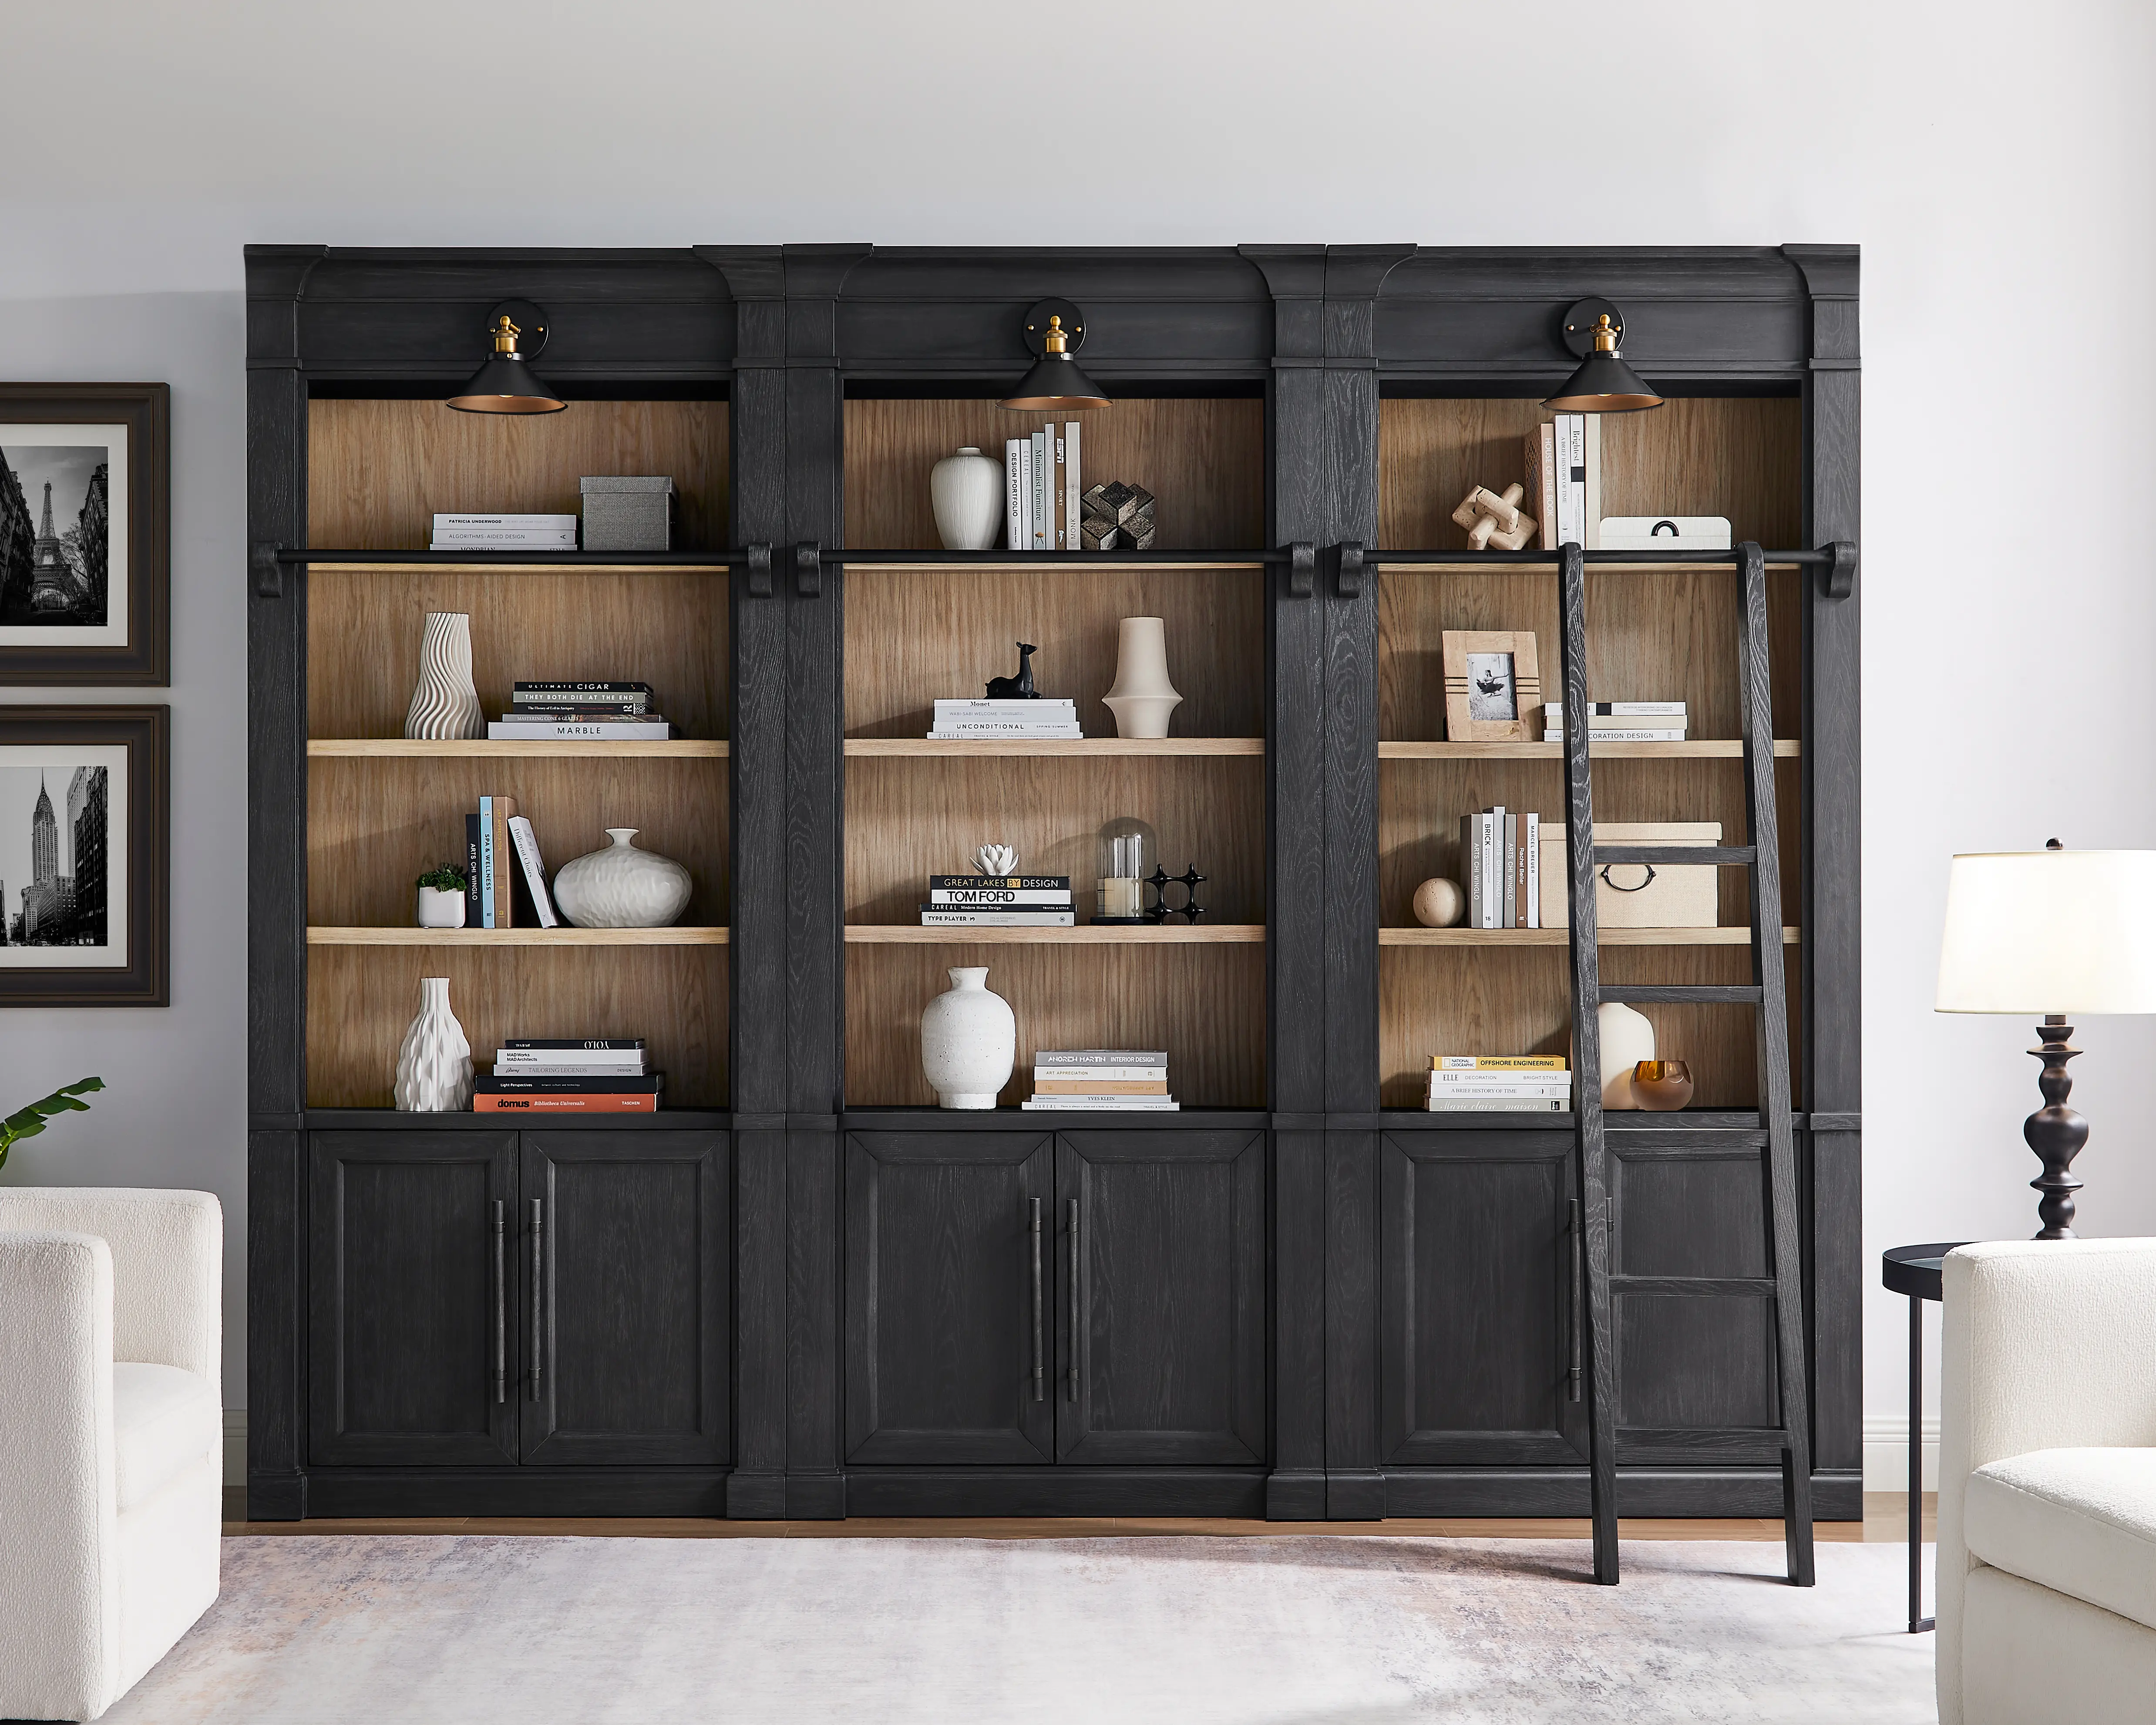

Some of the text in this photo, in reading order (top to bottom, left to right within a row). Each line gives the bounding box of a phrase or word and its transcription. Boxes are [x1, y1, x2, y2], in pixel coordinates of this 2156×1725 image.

[1571, 431, 1581, 461] Brightest
[1546, 465, 1552, 476] OF
[514, 829, 527, 856] Different
[524, 857, 532, 878] Chairs
[947, 891, 1015, 902] TOM FORD
[498, 1099, 530, 1108] domus
[1440, 1100, 1469, 1110] Marie
[1471, 1101, 1498, 1110] claire
